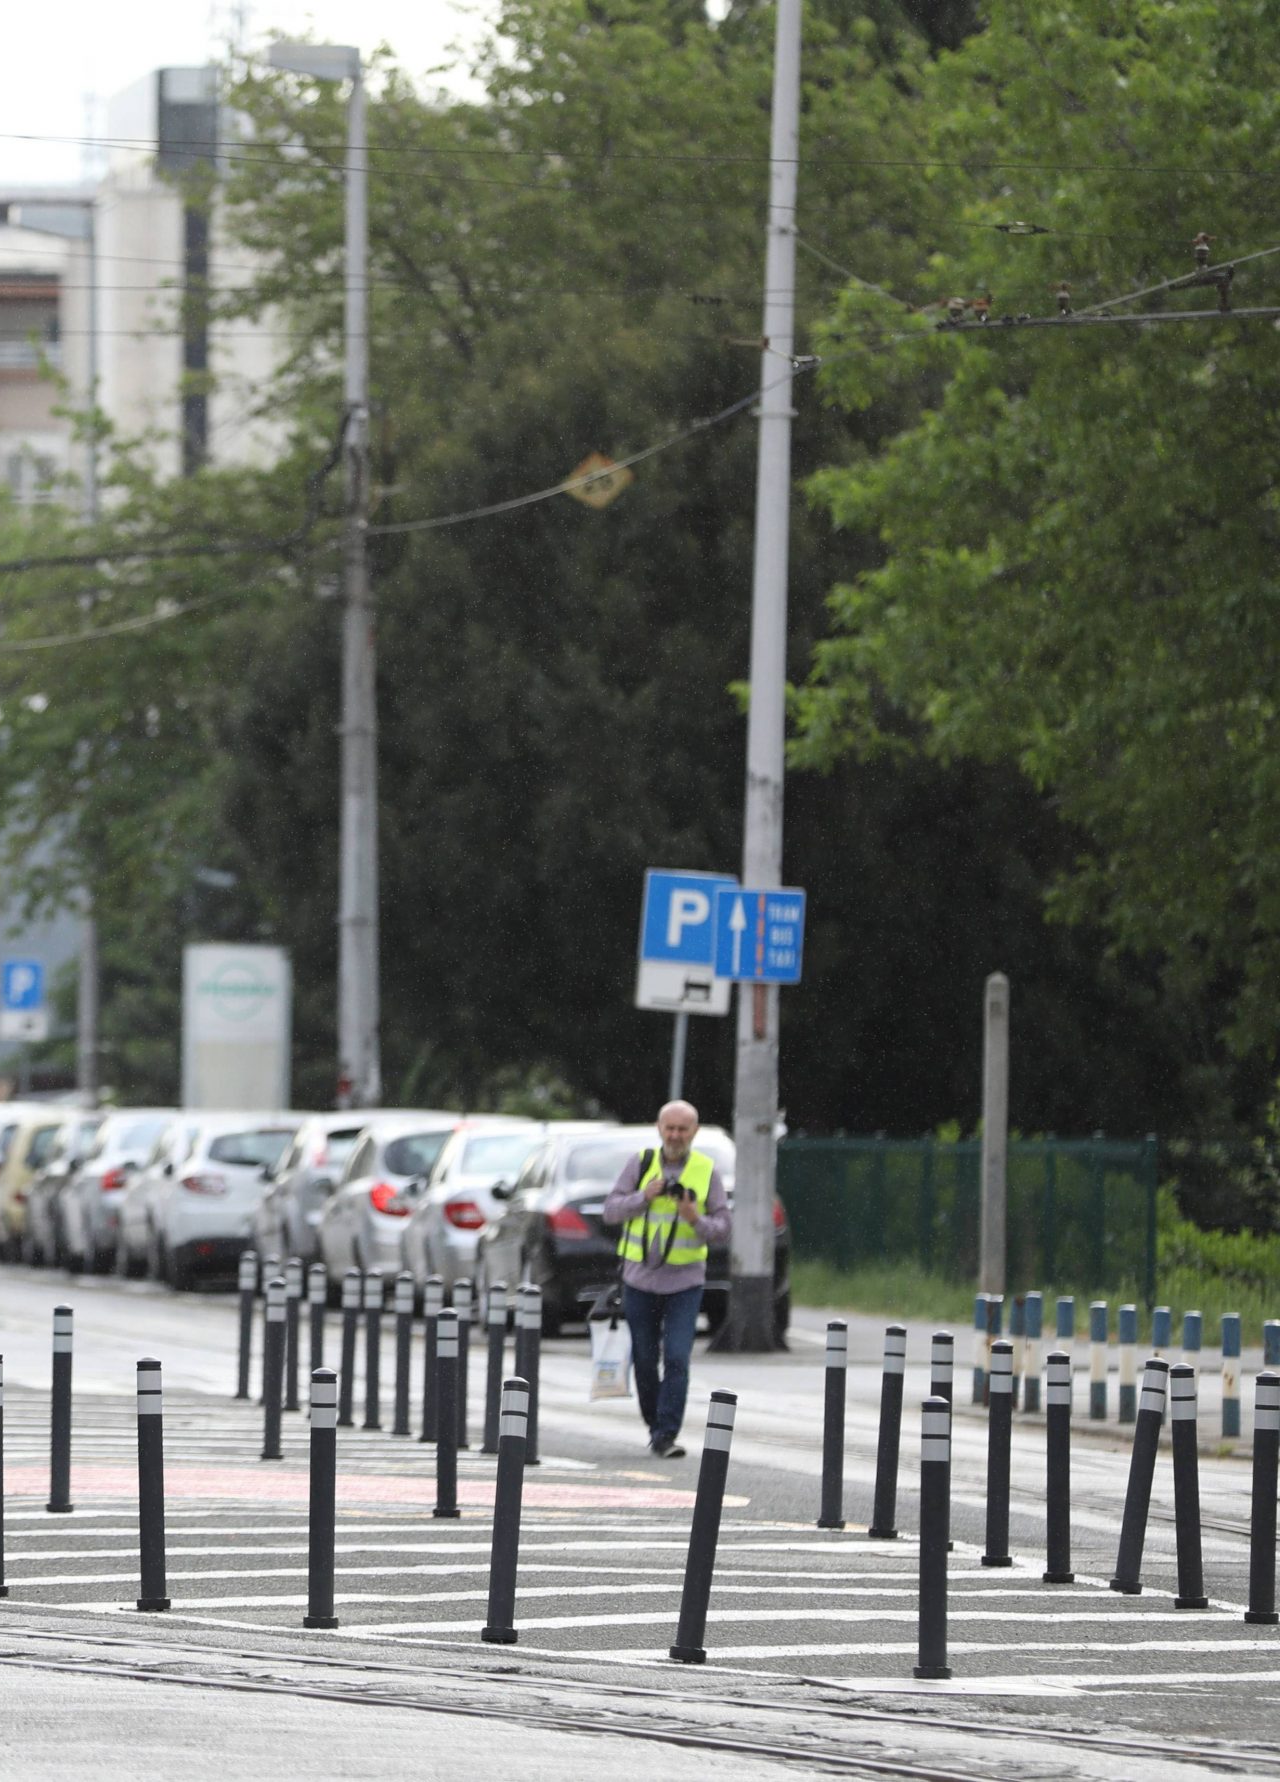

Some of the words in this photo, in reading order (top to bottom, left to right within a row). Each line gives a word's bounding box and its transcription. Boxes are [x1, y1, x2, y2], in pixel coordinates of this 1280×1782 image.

[666, 889, 710, 947] P
[768, 903, 800, 923] TRAM
[771, 925, 793, 946] BUS
